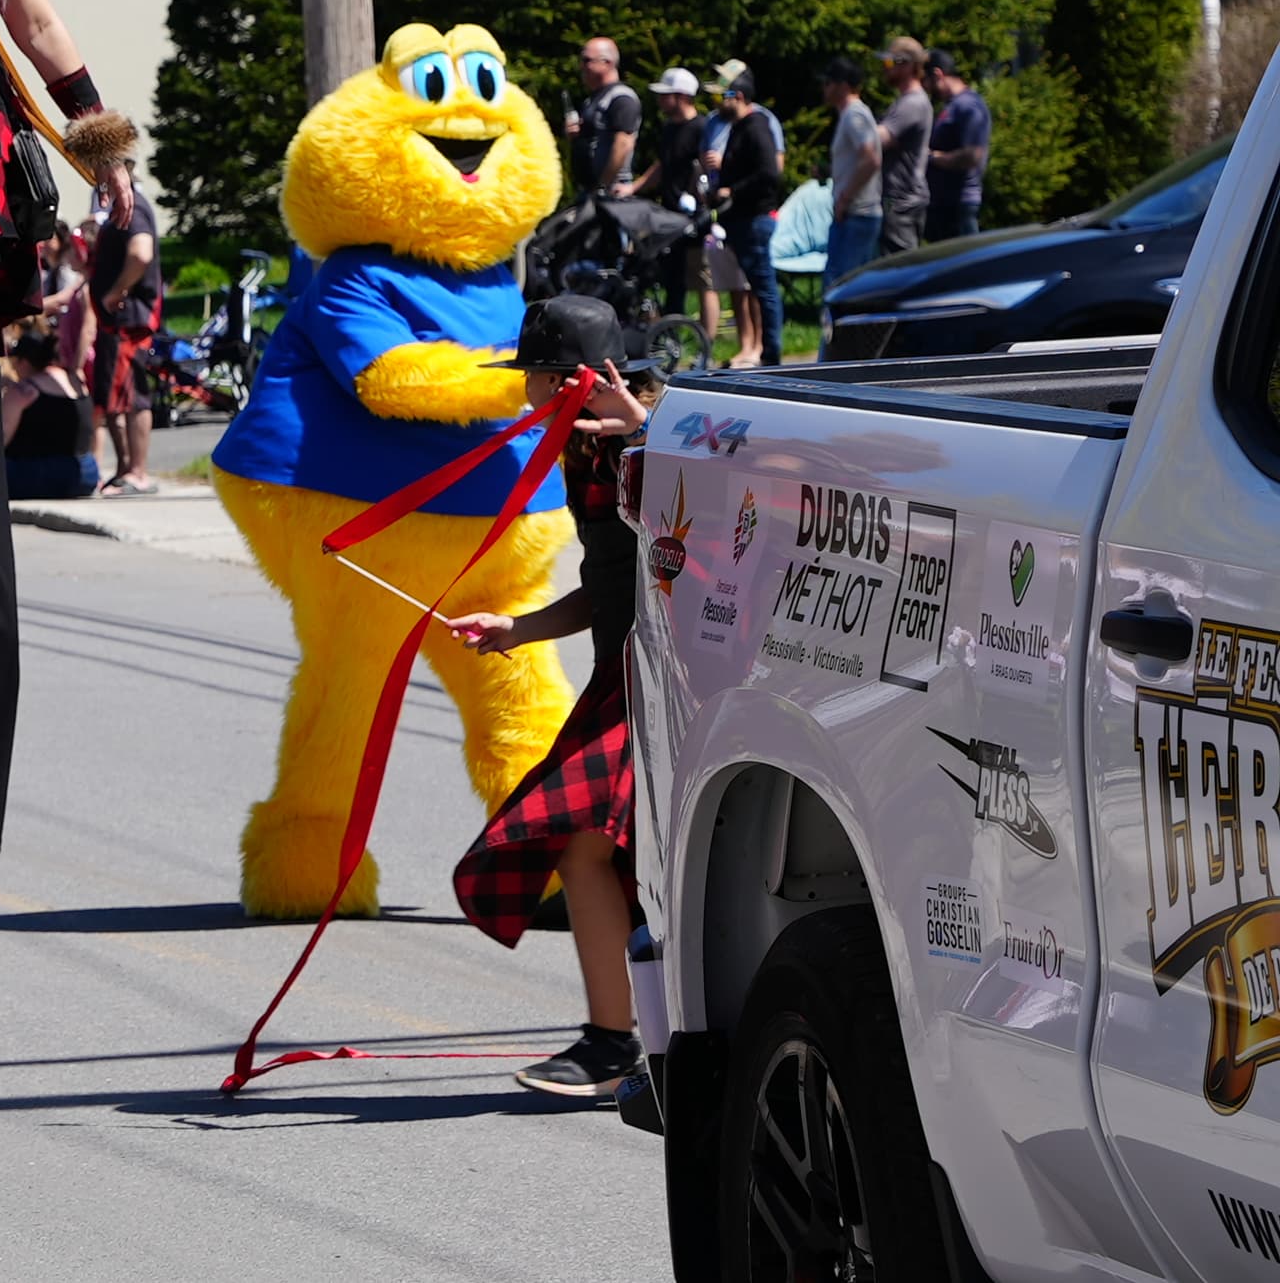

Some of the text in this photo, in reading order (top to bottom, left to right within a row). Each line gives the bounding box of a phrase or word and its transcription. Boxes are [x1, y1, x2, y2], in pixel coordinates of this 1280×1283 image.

[772, 556, 883, 637] MÉTHOT
[908, 553, 946, 597] TROP
[896, 598, 940, 643] FORT
[978, 613, 1050, 660] Plessisville
[761, 633, 805, 664] Plessisville
[813, 645, 864, 678] Victoriaville
[1197, 631, 1280, 703] LE FE
[975, 765, 1030, 826] PLESS
[926, 898, 981, 926] CHRISTIAN
[937, 883, 967, 902] GROUPE
[927, 919, 982, 953] GOSSELIN
[1003, 921, 1034, 965] Fruit
[1242, 950, 1276, 1024] DE
